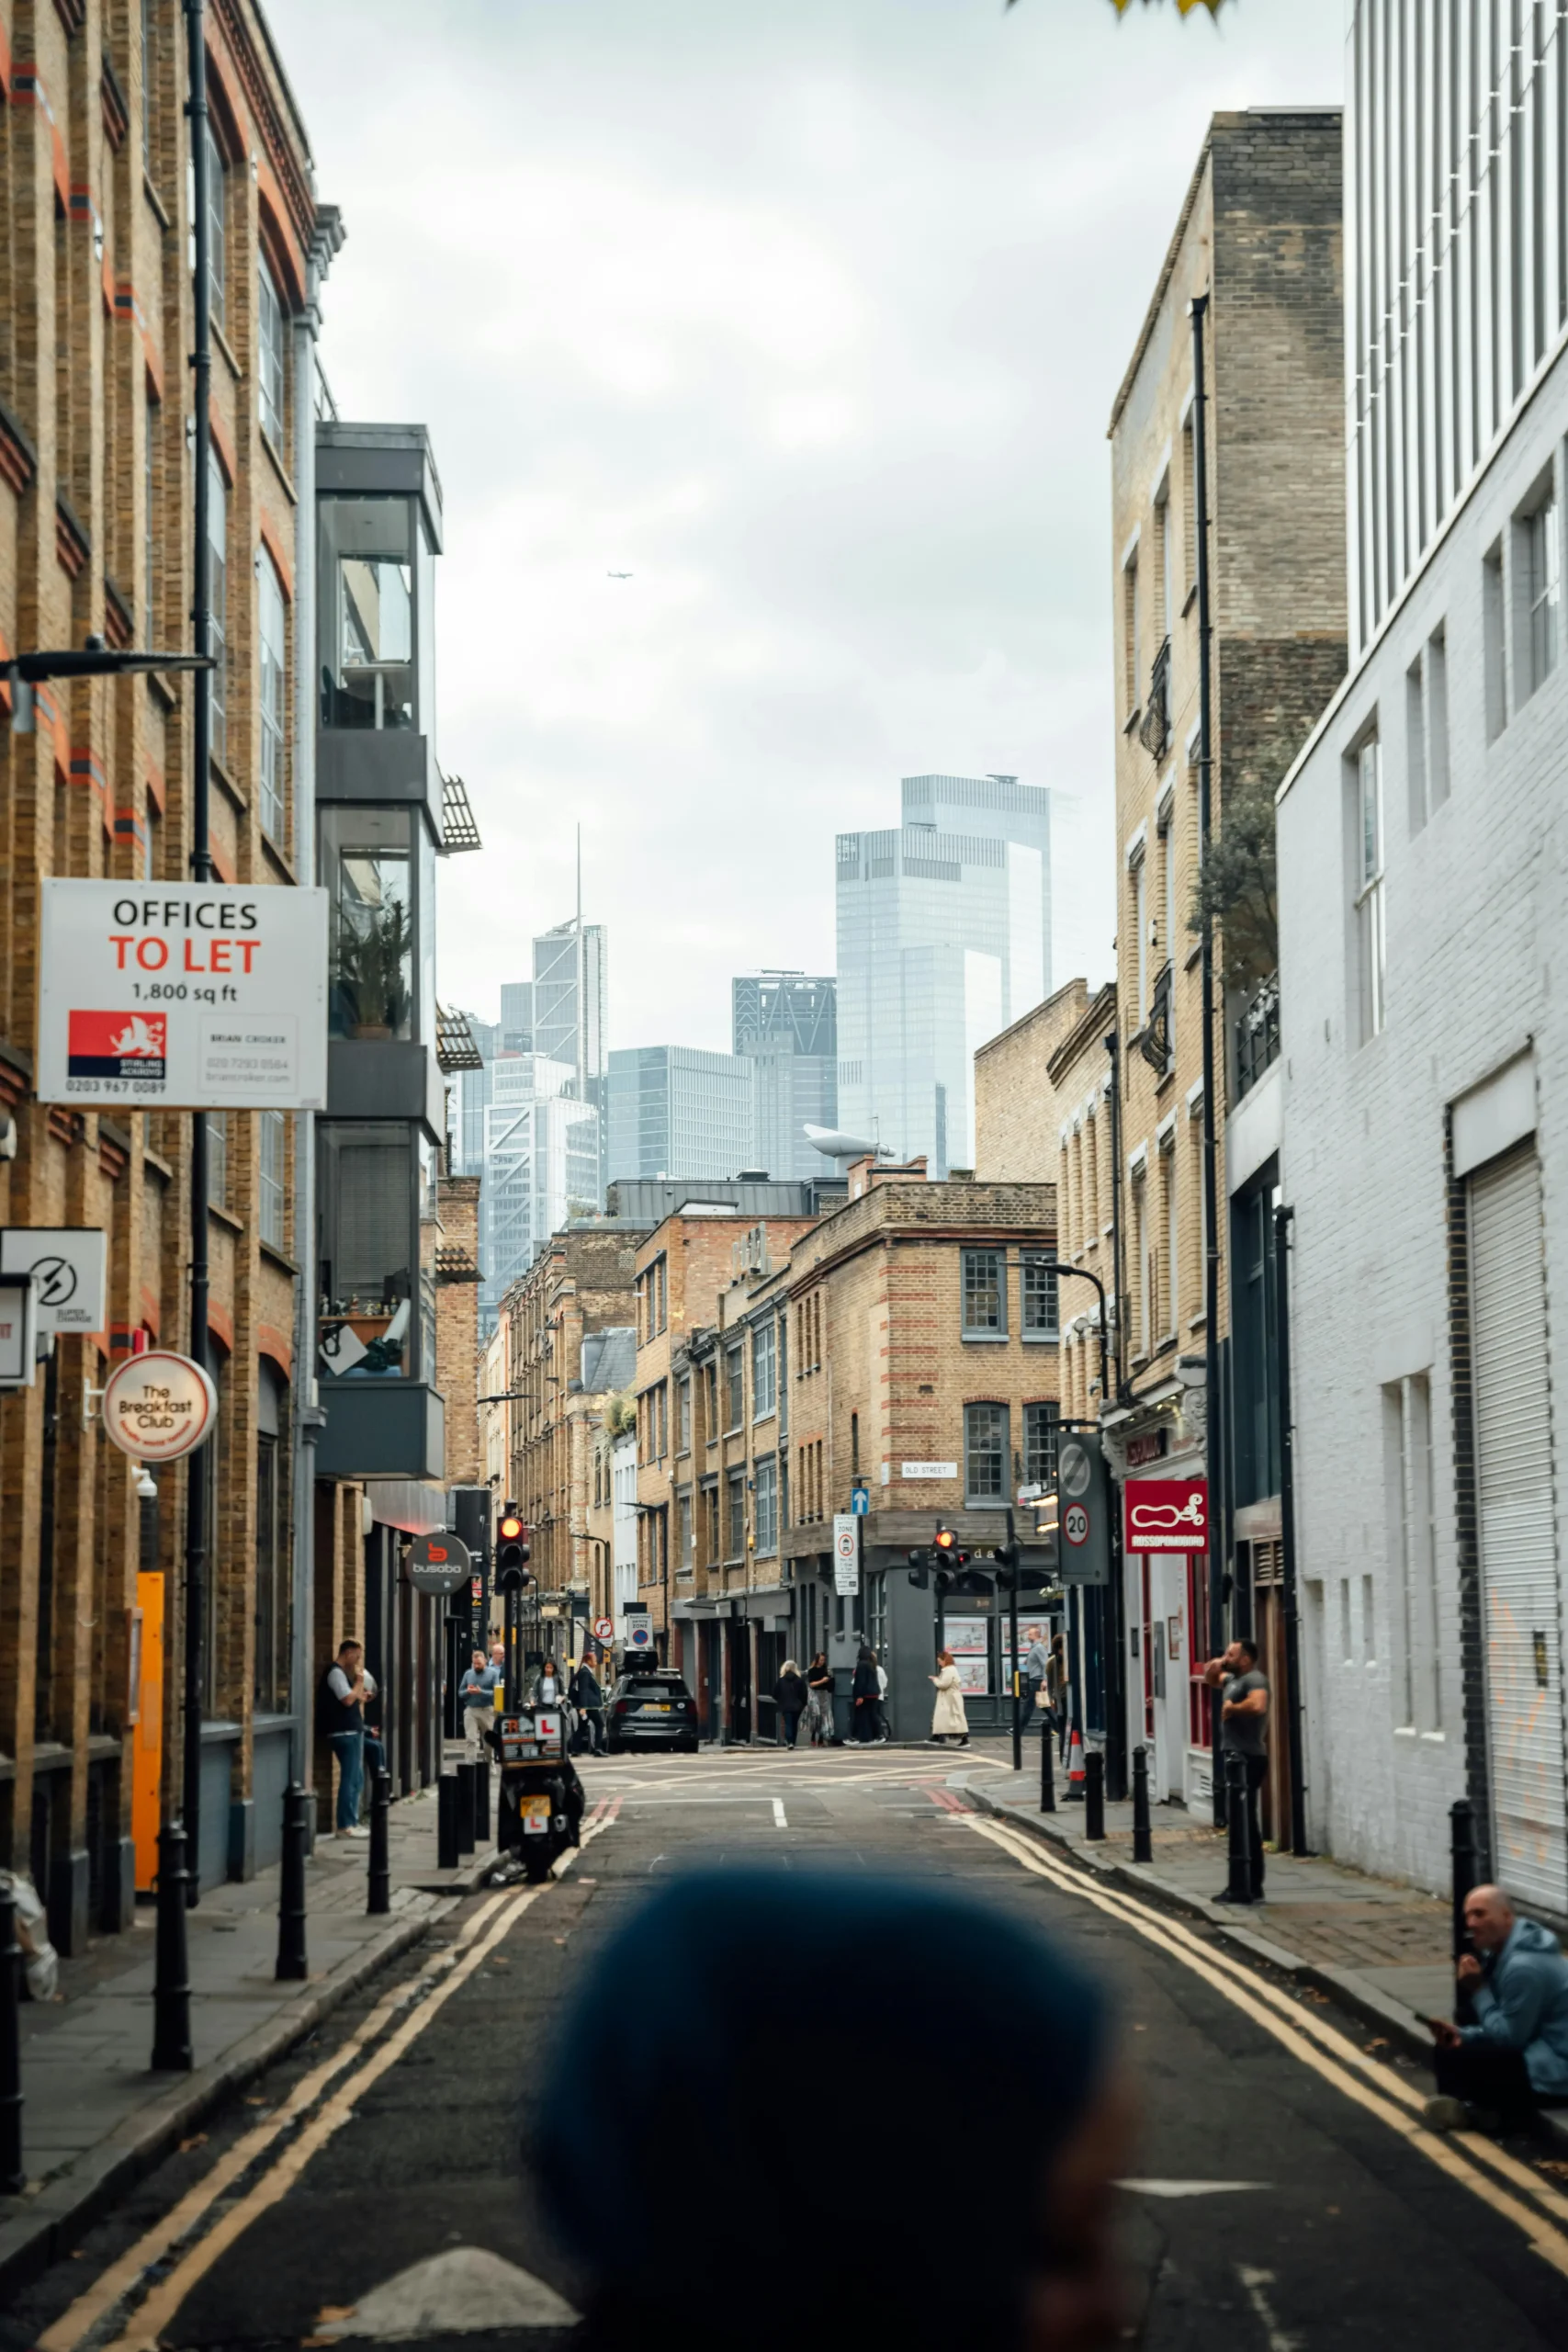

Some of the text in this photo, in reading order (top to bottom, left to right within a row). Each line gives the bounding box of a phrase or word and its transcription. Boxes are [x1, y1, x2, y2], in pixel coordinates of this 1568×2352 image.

[113, 899, 257, 930] OFFICES
[108, 935, 262, 974] TO LET
[132, 982, 238, 1004] 1,800 sq ft
[209, 1034, 242, 1043] BRIAN
[103, 1080, 129, 1092] 967
[143, 1385, 170, 1398] The
[119, 1401, 192, 1414] Breakfast
[137, 1415, 175, 1429] Club
[906, 1465, 947, 1474] OLD STREET
[1067, 1515, 1087, 1533] 20
[412, 1564, 461, 1573] busaba
[541, 1719, 555, 1735] L
[530, 1816, 542, 1829] L
